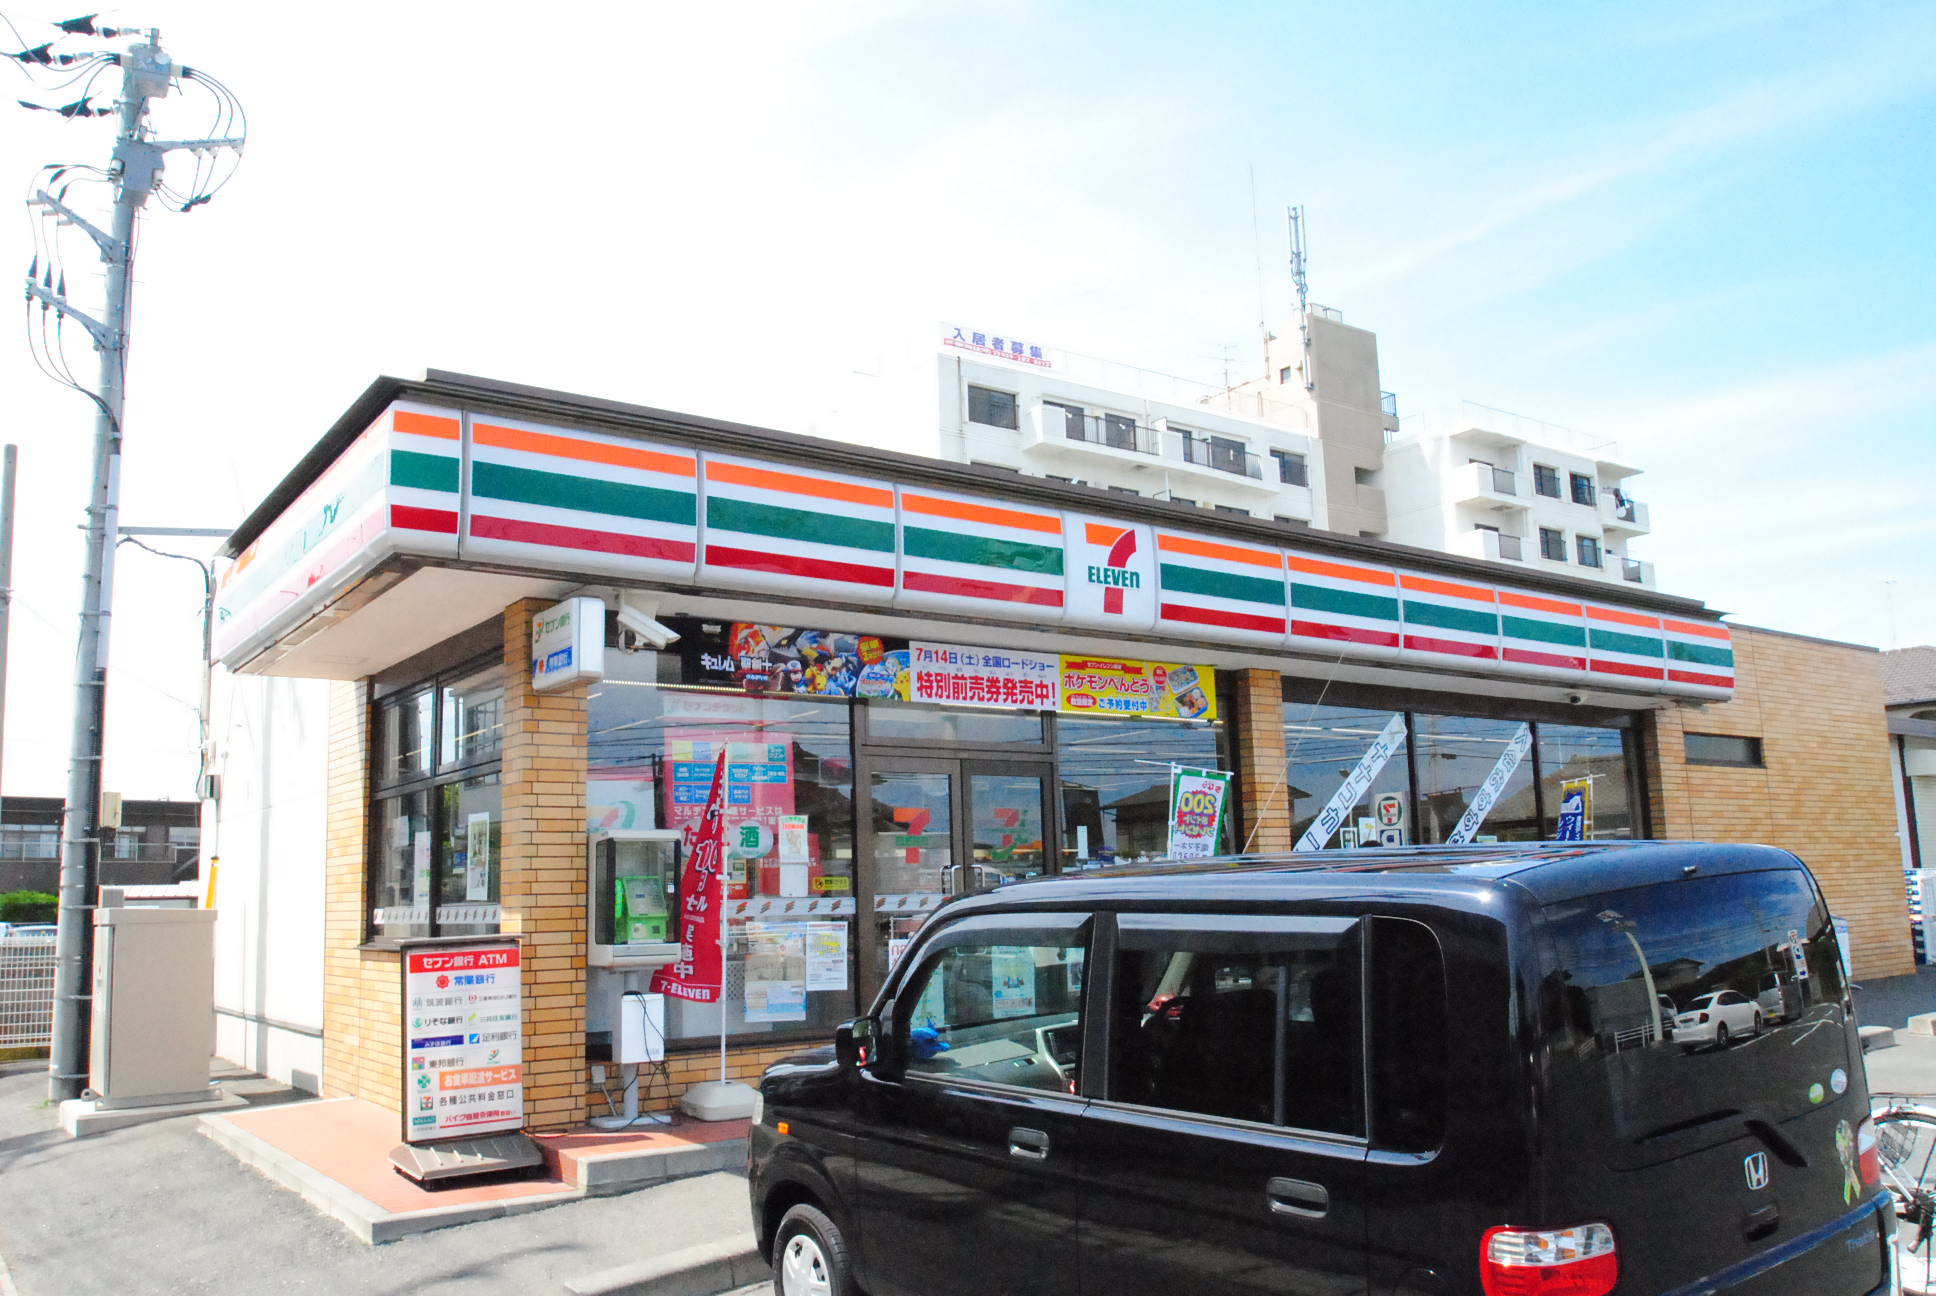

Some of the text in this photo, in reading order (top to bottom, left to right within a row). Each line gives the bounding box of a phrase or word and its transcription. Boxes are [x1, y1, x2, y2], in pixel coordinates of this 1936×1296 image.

[700, 653, 735, 672] キュレム
[740, 826, 760, 848] 酒
[422, 953, 508, 969] セブン銀行 ATM
